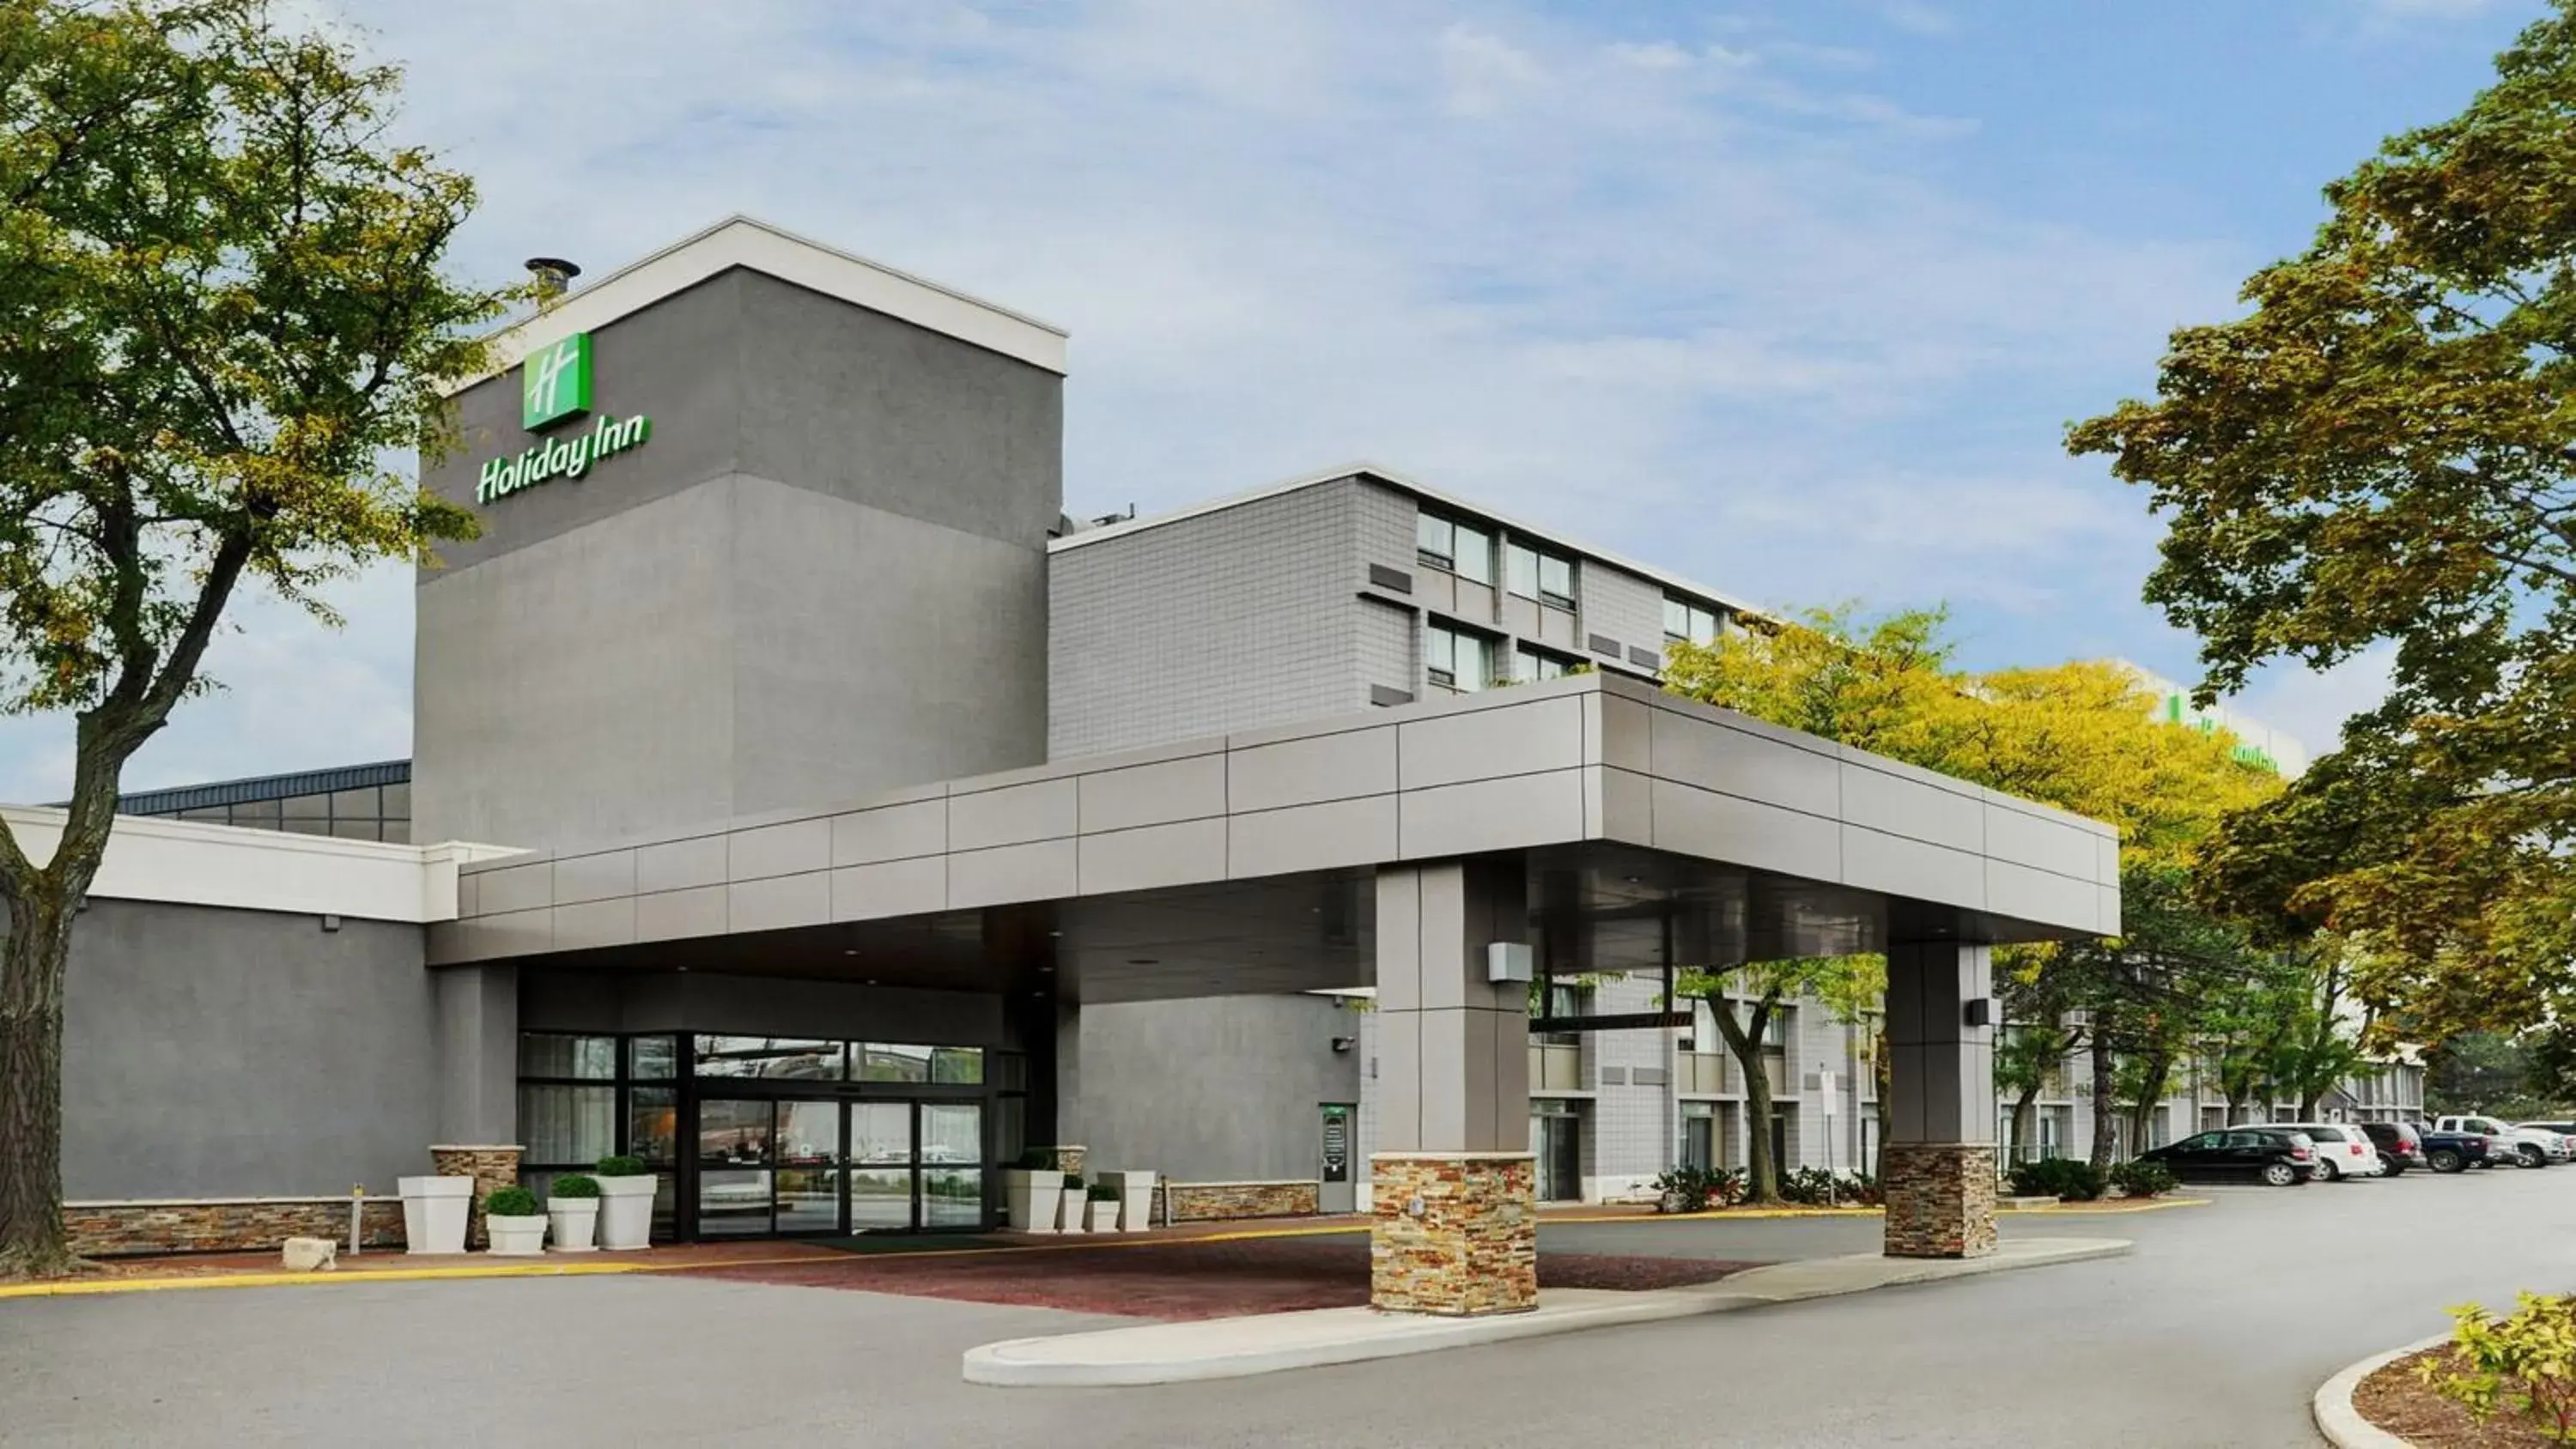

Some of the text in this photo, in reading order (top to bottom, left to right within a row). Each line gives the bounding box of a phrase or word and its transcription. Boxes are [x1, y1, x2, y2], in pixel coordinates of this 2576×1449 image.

[529, 343, 580, 415] H
[476, 415, 646, 504] Holiday Inn
